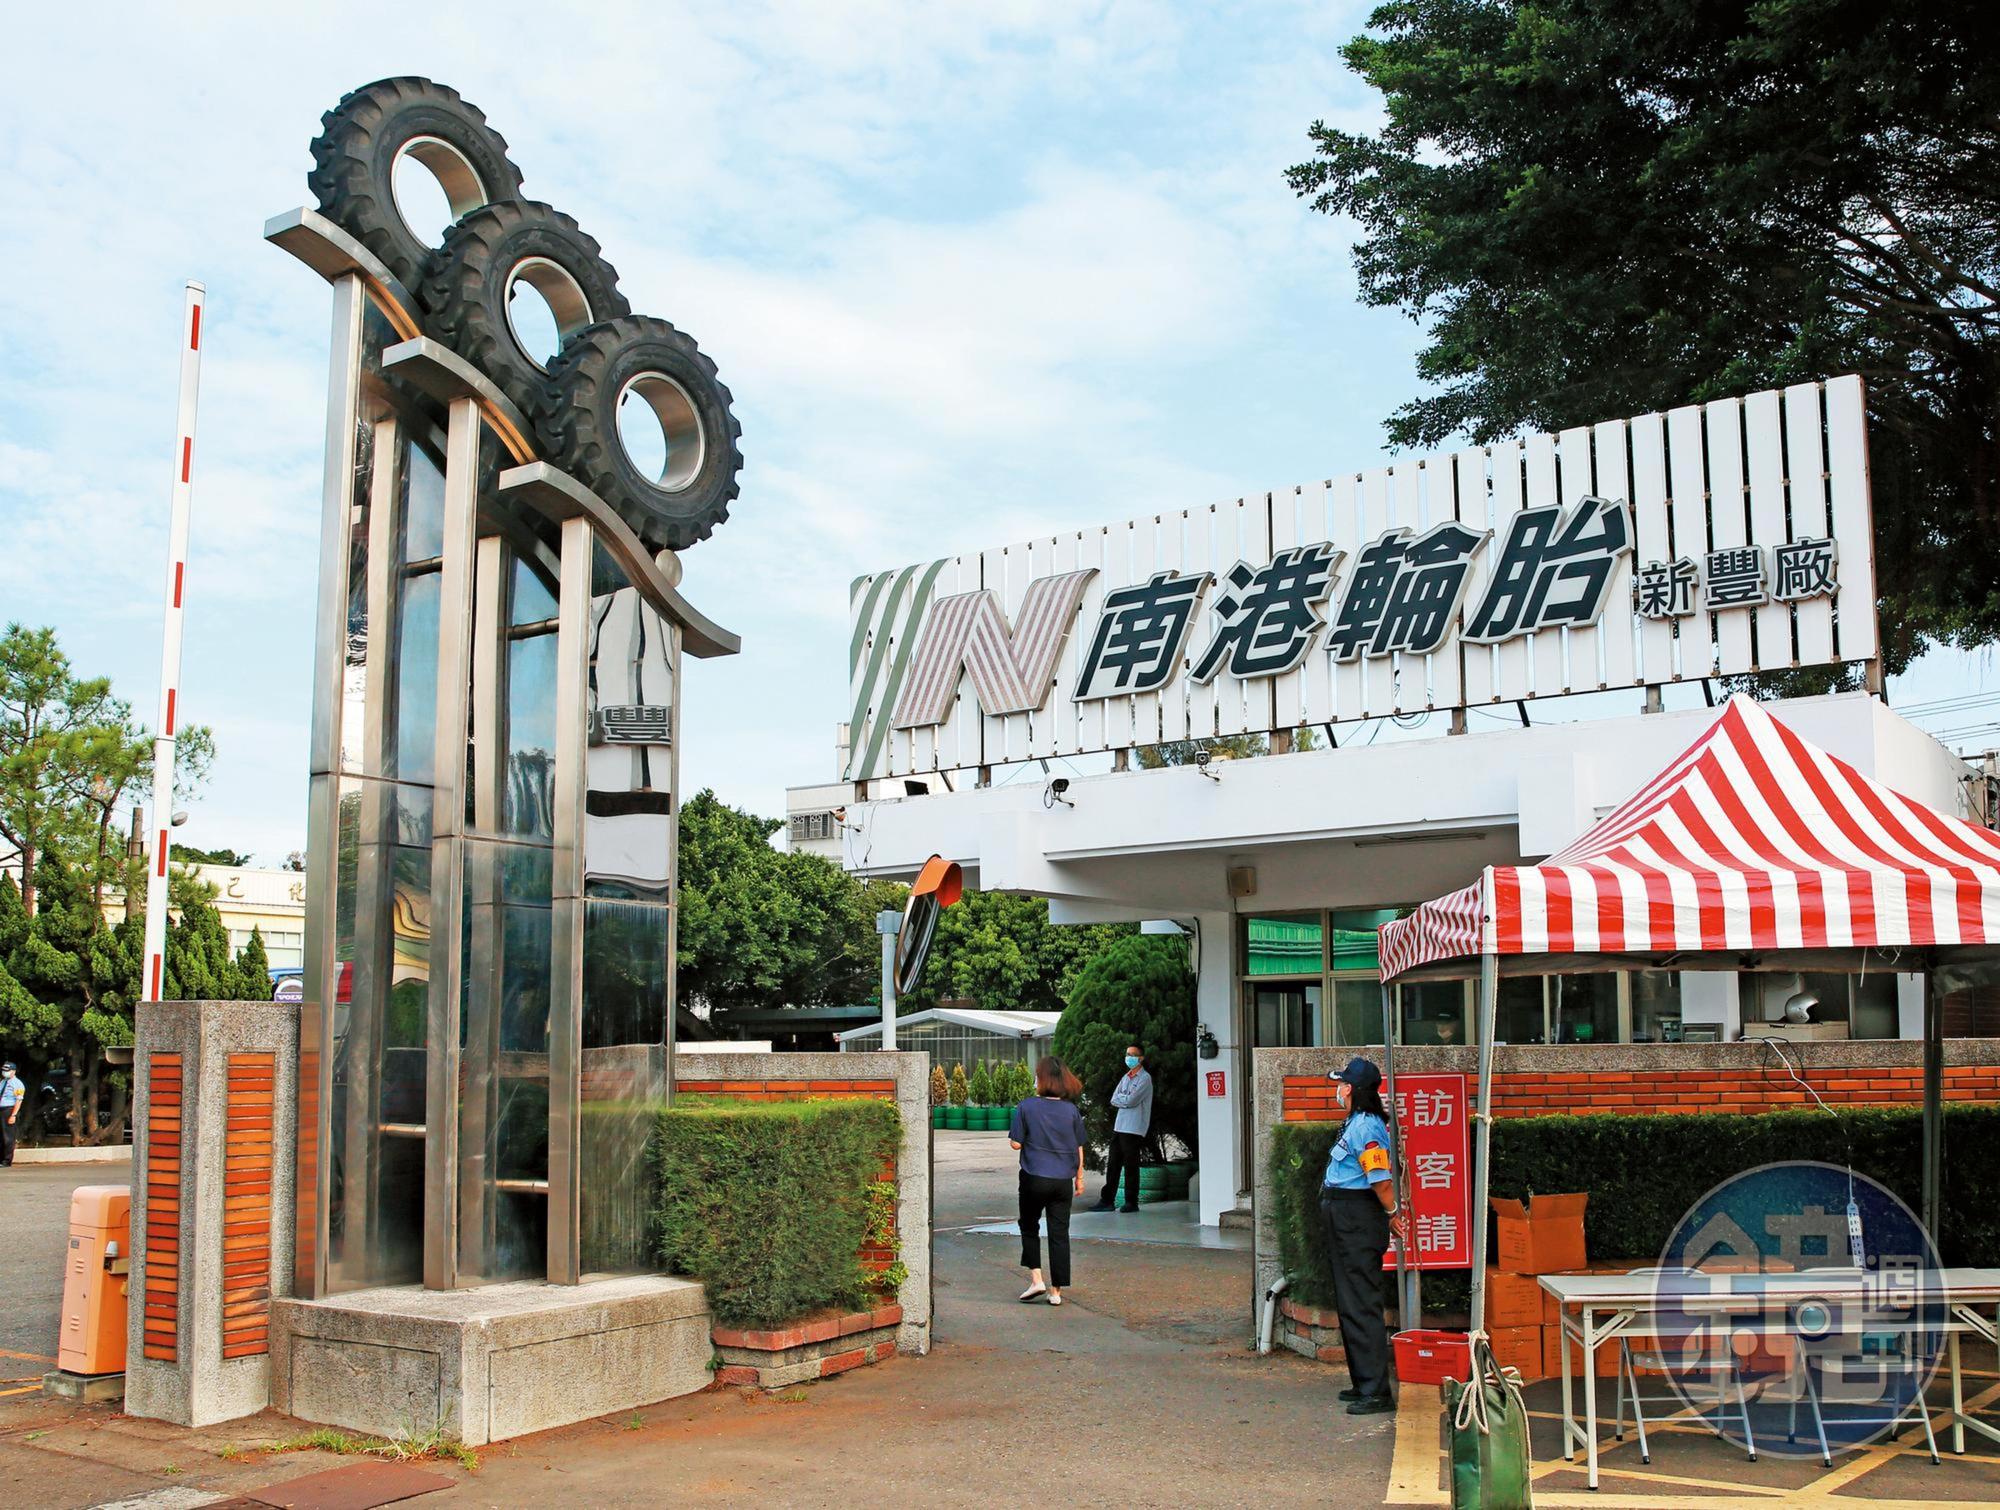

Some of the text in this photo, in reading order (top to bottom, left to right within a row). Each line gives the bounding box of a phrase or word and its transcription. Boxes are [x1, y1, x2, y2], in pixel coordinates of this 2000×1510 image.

[1073, 495, 1634, 702] 南港輪胎
[1638, 537, 1841, 619] 新豐廠
[1413, 1089, 1457, 1252] 訪客請
